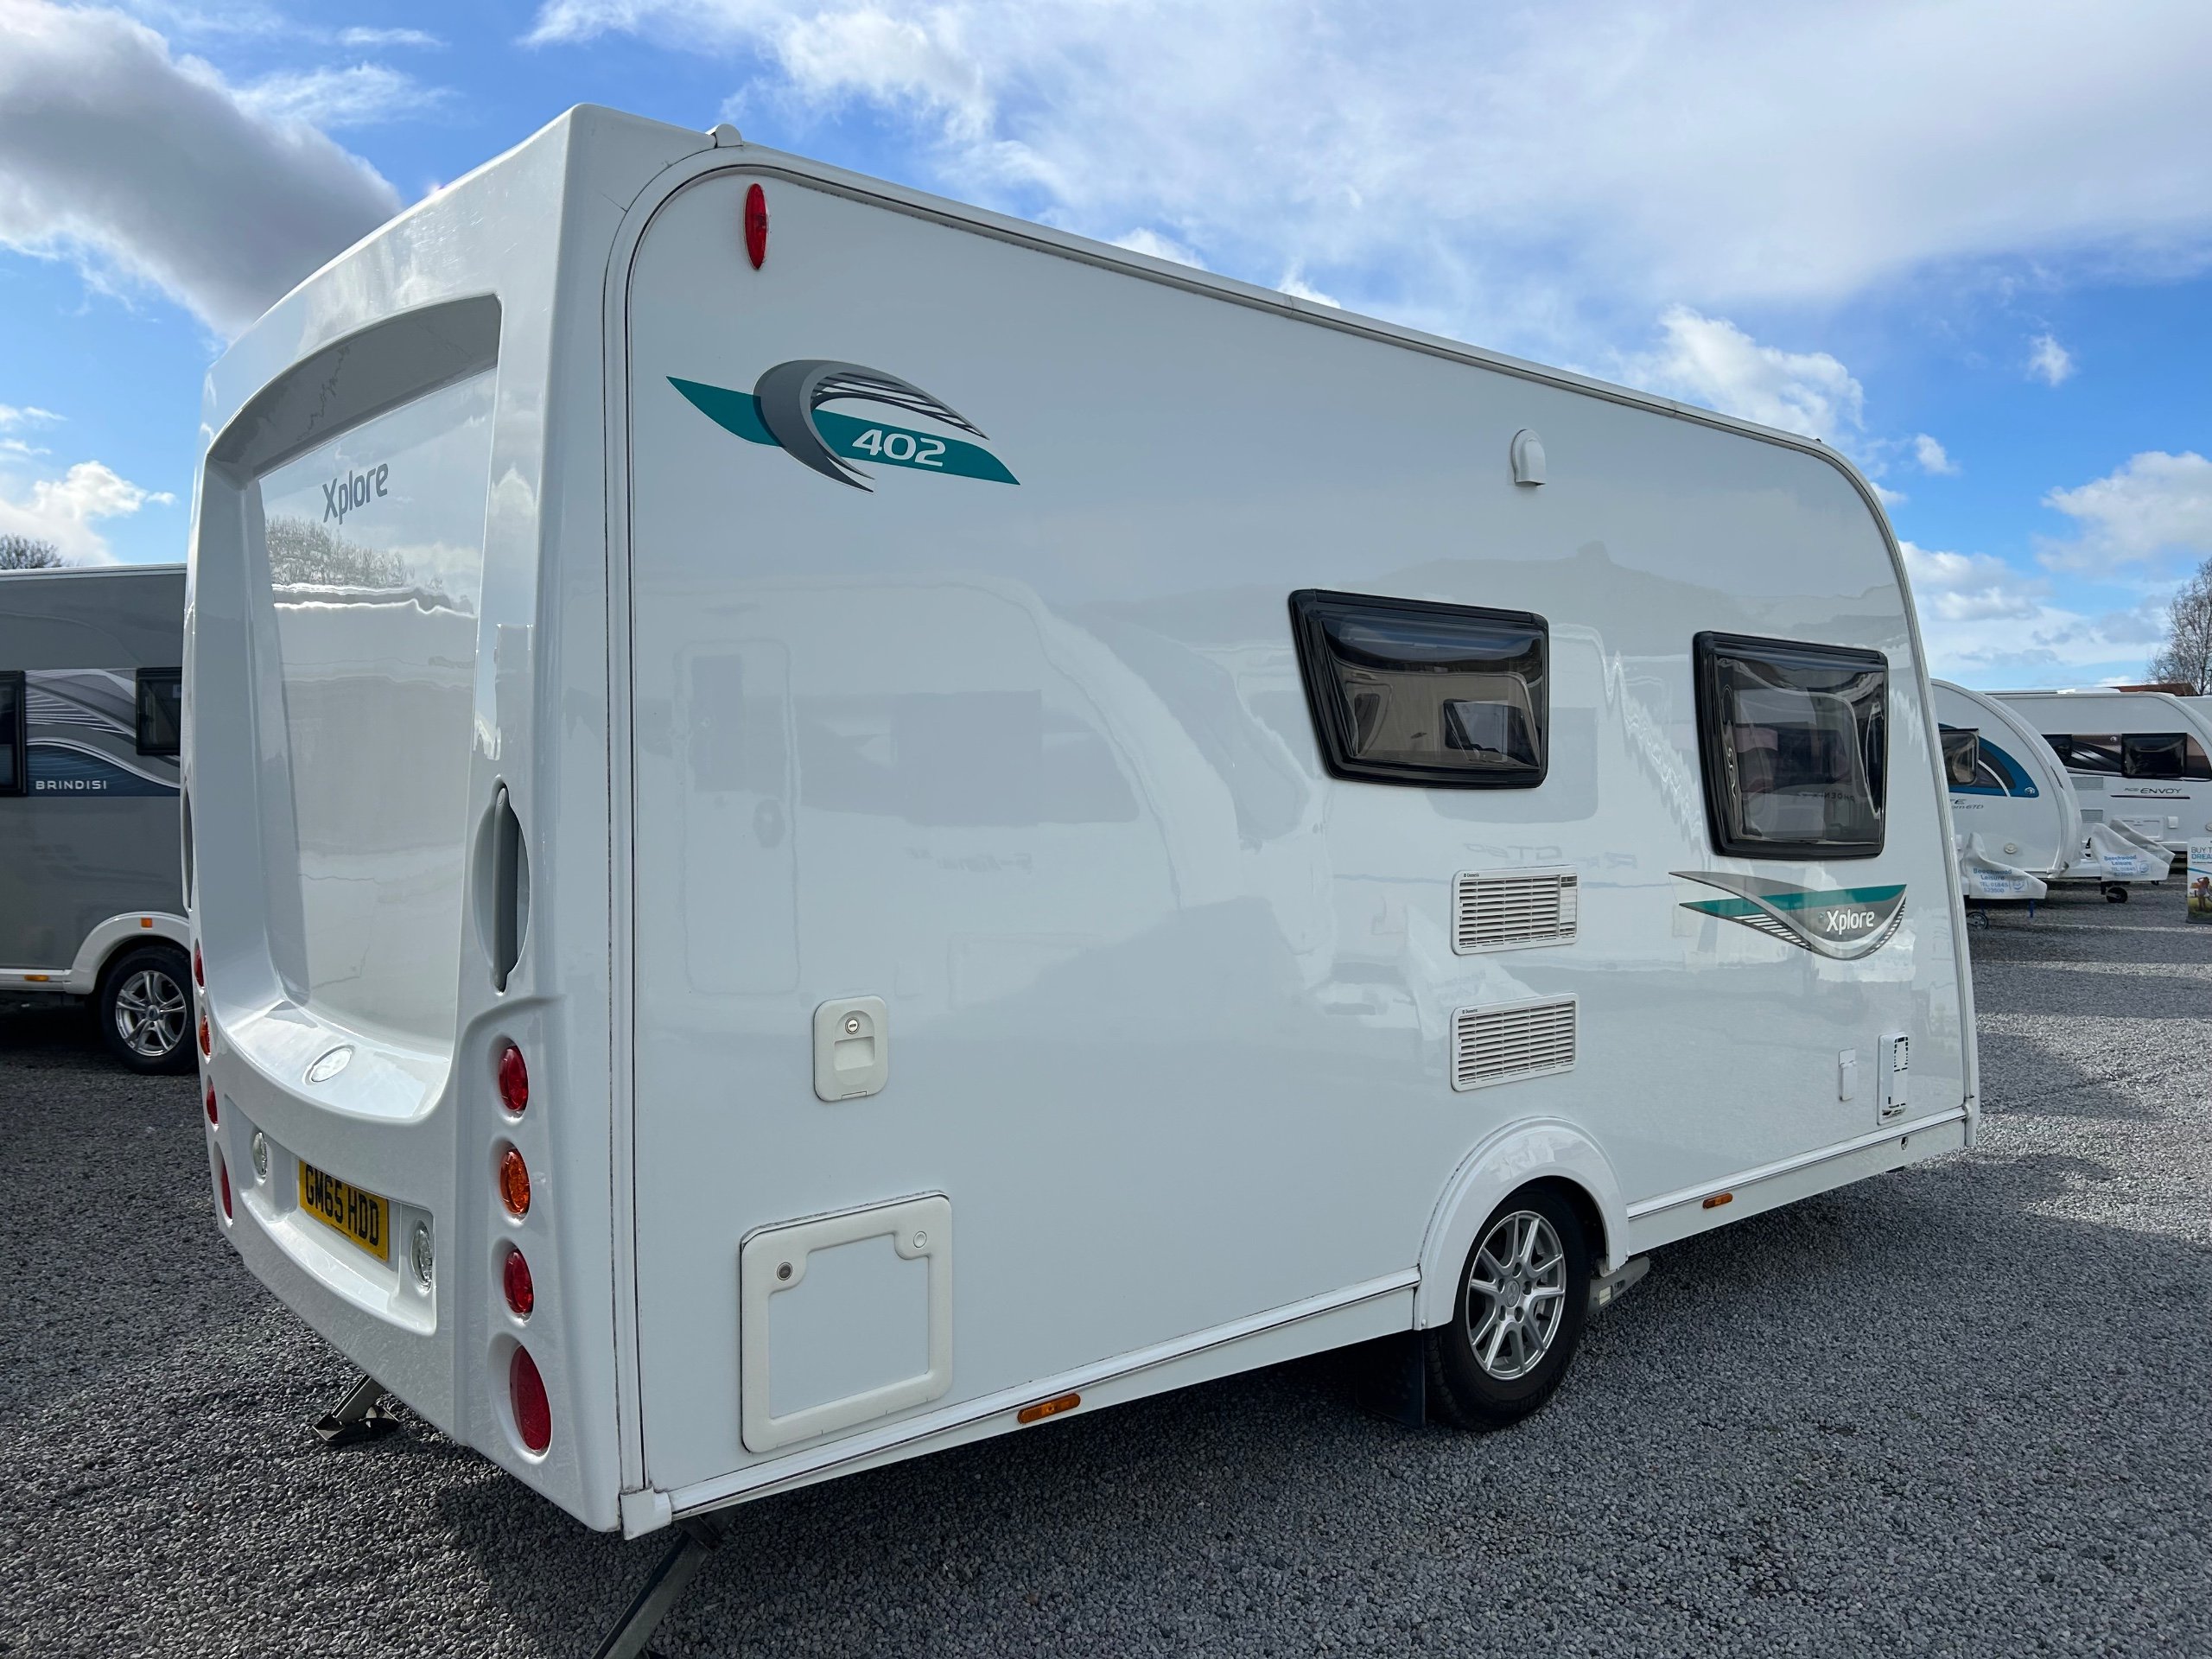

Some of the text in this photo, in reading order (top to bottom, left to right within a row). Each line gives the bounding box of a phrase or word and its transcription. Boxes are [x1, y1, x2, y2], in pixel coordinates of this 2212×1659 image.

[851, 429, 946, 467] 402
[321, 462, 389, 525] Xplore
[35, 779, 107, 790] BRINDISI
[1826, 908, 1875, 936] Xplore
[305, 1163, 379, 1247] GM65 HDD
